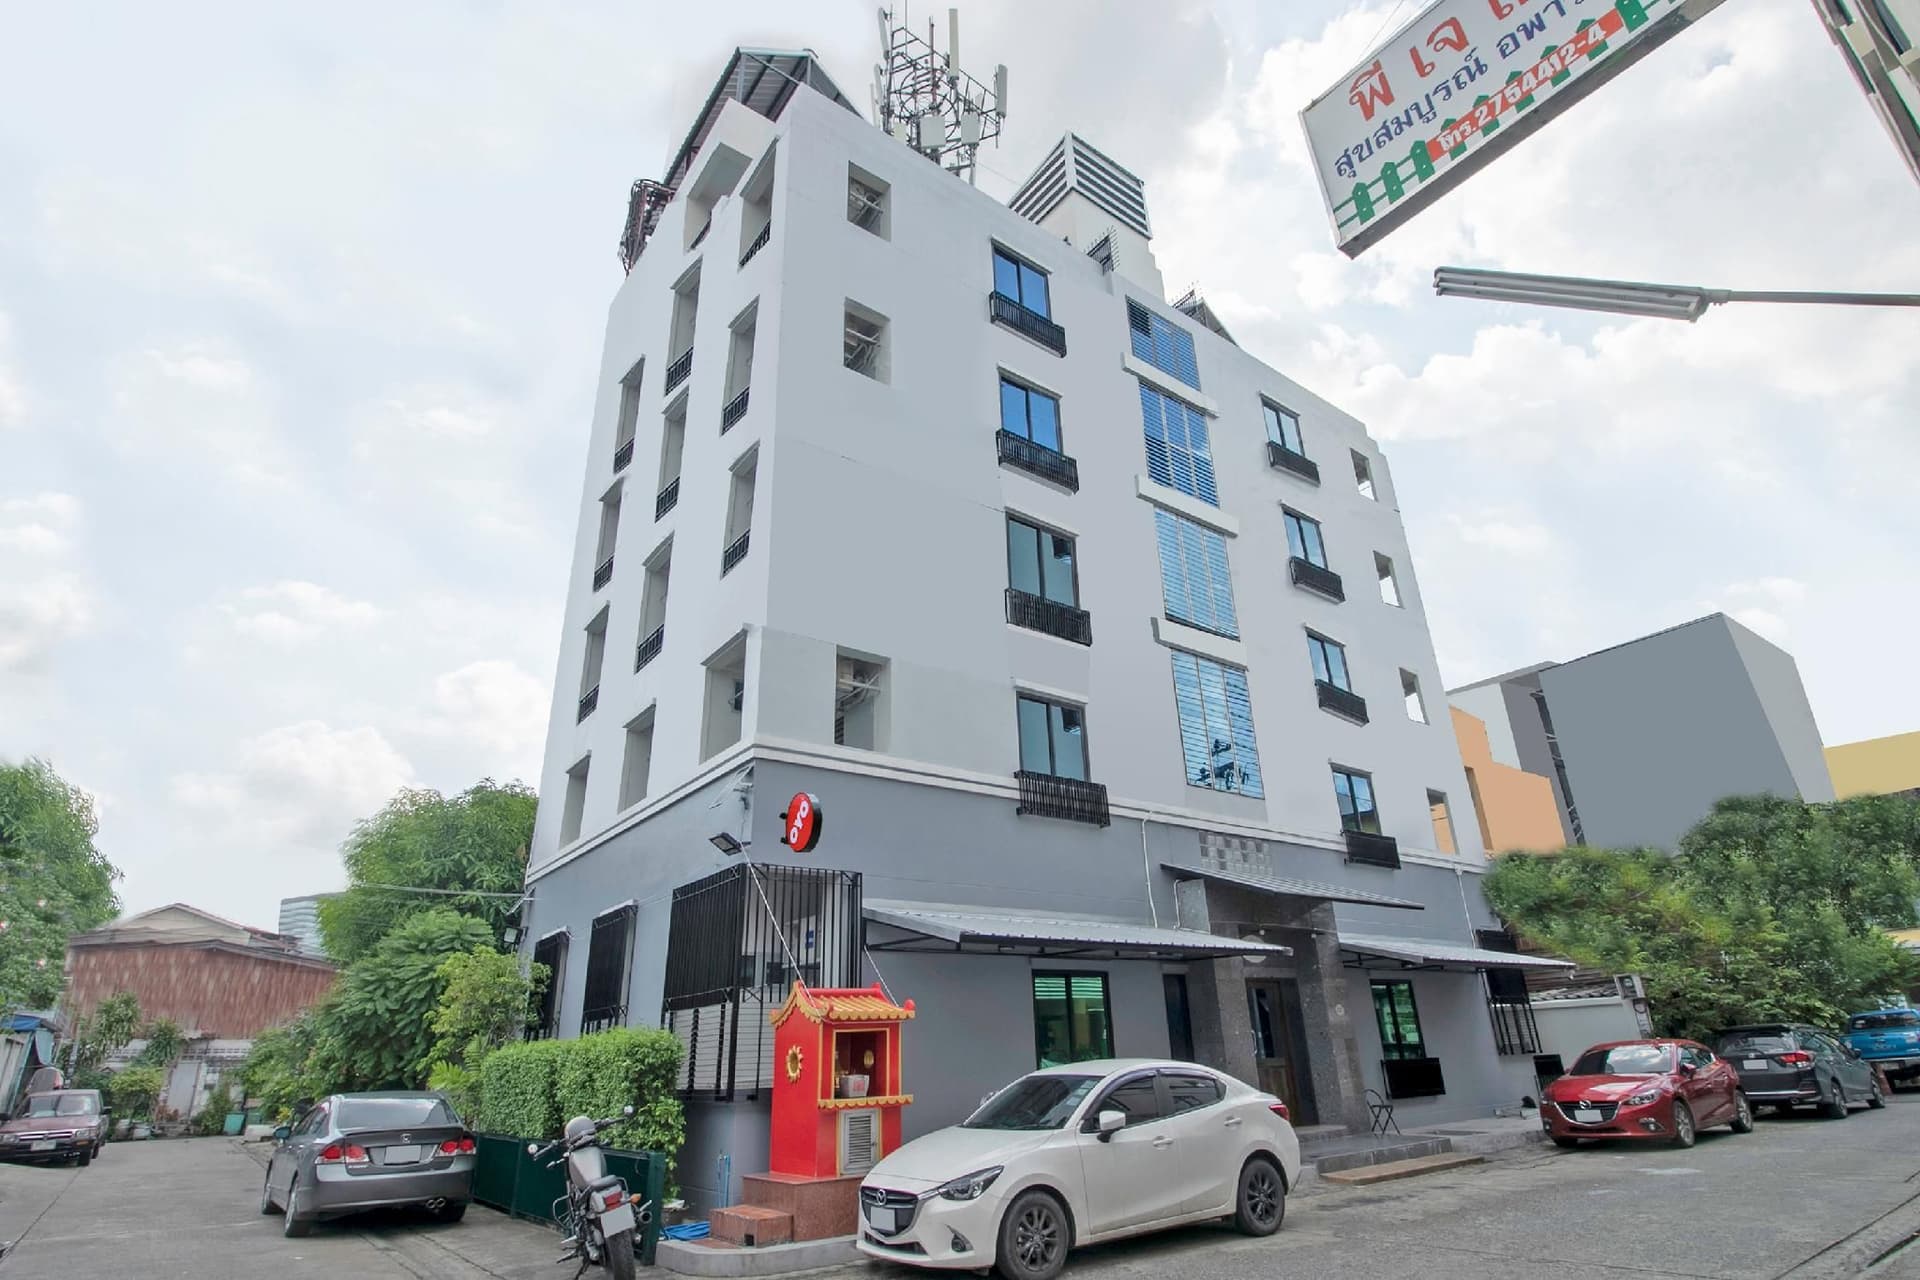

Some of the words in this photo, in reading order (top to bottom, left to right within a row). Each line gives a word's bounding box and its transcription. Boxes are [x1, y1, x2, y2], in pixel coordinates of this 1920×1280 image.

[1409, 16, 1470, 78] เจ
[1335, 46, 1489, 179] สุขสมบูรณ์
[1496, 0, 1584, 60] อพา
[790, 800, 809, 844] OYO
